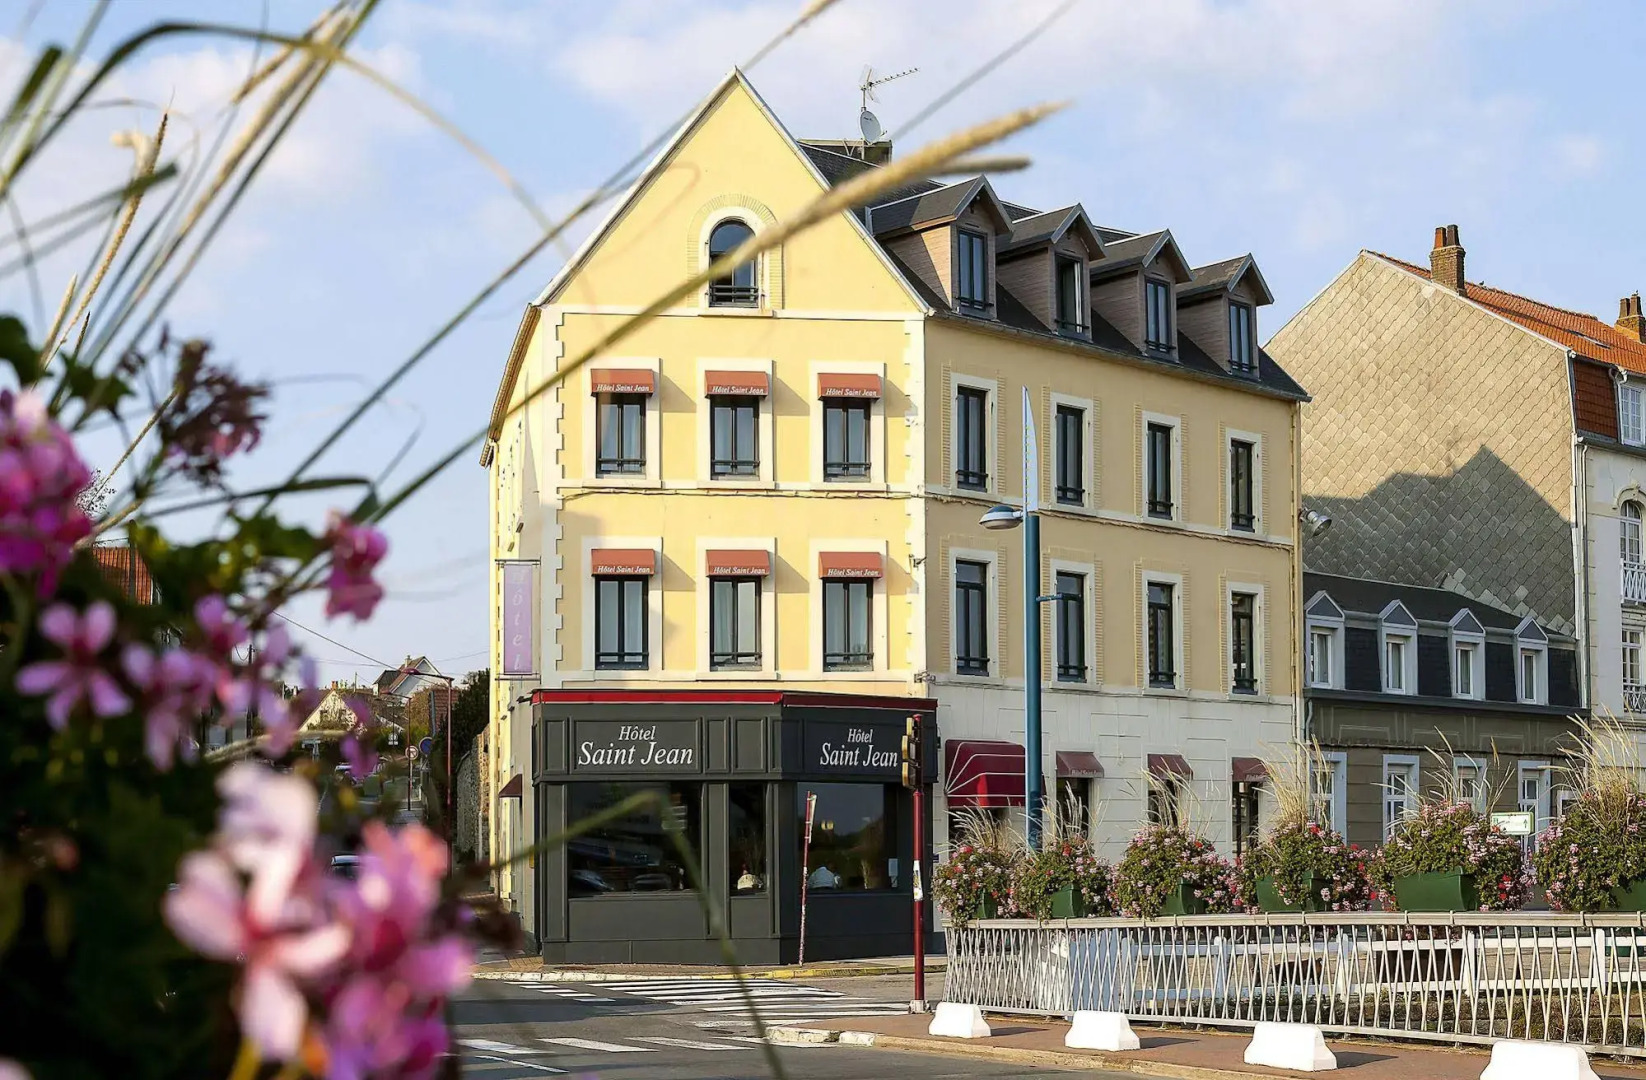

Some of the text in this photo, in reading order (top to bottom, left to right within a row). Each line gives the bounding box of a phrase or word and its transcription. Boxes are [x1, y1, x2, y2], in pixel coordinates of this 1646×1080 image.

[596, 383, 650, 392] Hôtel Saint Jean
[730, 386, 748, 394] Saint
[749, 386, 764, 394] Jean
[826, 388, 843, 396] Hôtel
[597, 565, 615, 573] Hôtel
[713, 566, 732, 574] Hôtel
[828, 568, 845, 576] Hôtel
[618, 725, 656, 741] Hôtel
[847, 728, 873, 743] Hôtel
[578, 741, 693, 765] Saint Jean
[820, 742, 898, 767] Saint Jean
